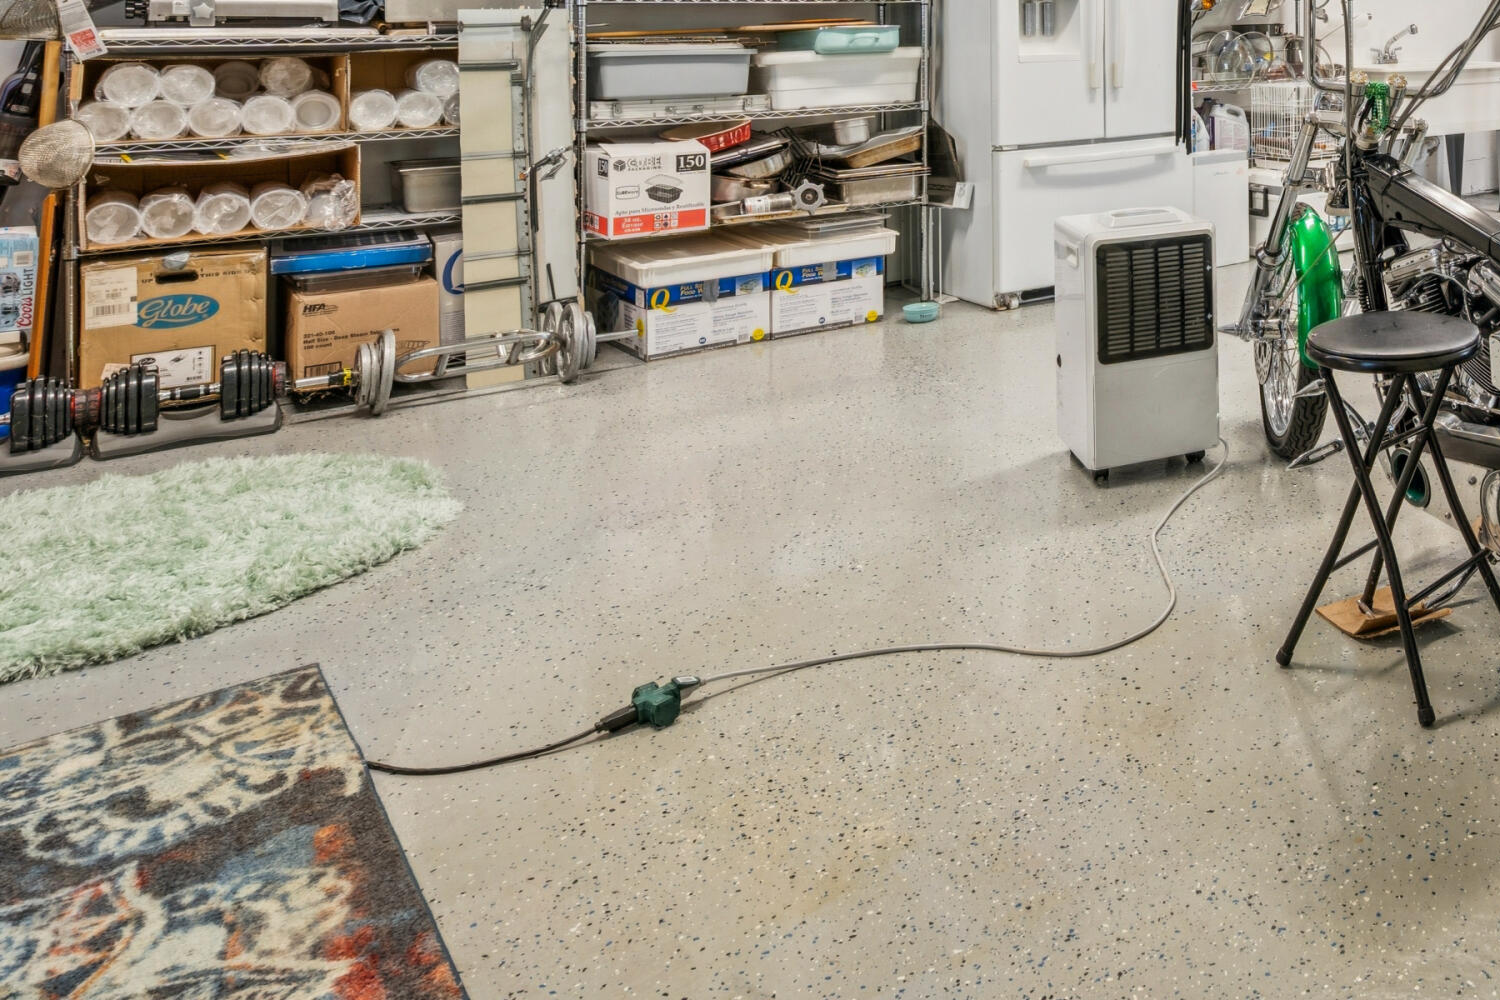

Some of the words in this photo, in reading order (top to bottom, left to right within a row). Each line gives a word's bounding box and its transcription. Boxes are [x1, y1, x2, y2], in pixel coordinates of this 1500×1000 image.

[679, 154, 704, 169] 150
[22, 268, 34, 296] LIGHT
[775, 270, 799, 294] Q
[16, 296, 33, 328] Coors
[138, 297, 211, 328] Globe
[303, 303, 326, 313] HFA
[650, 288, 678, 314] Q
